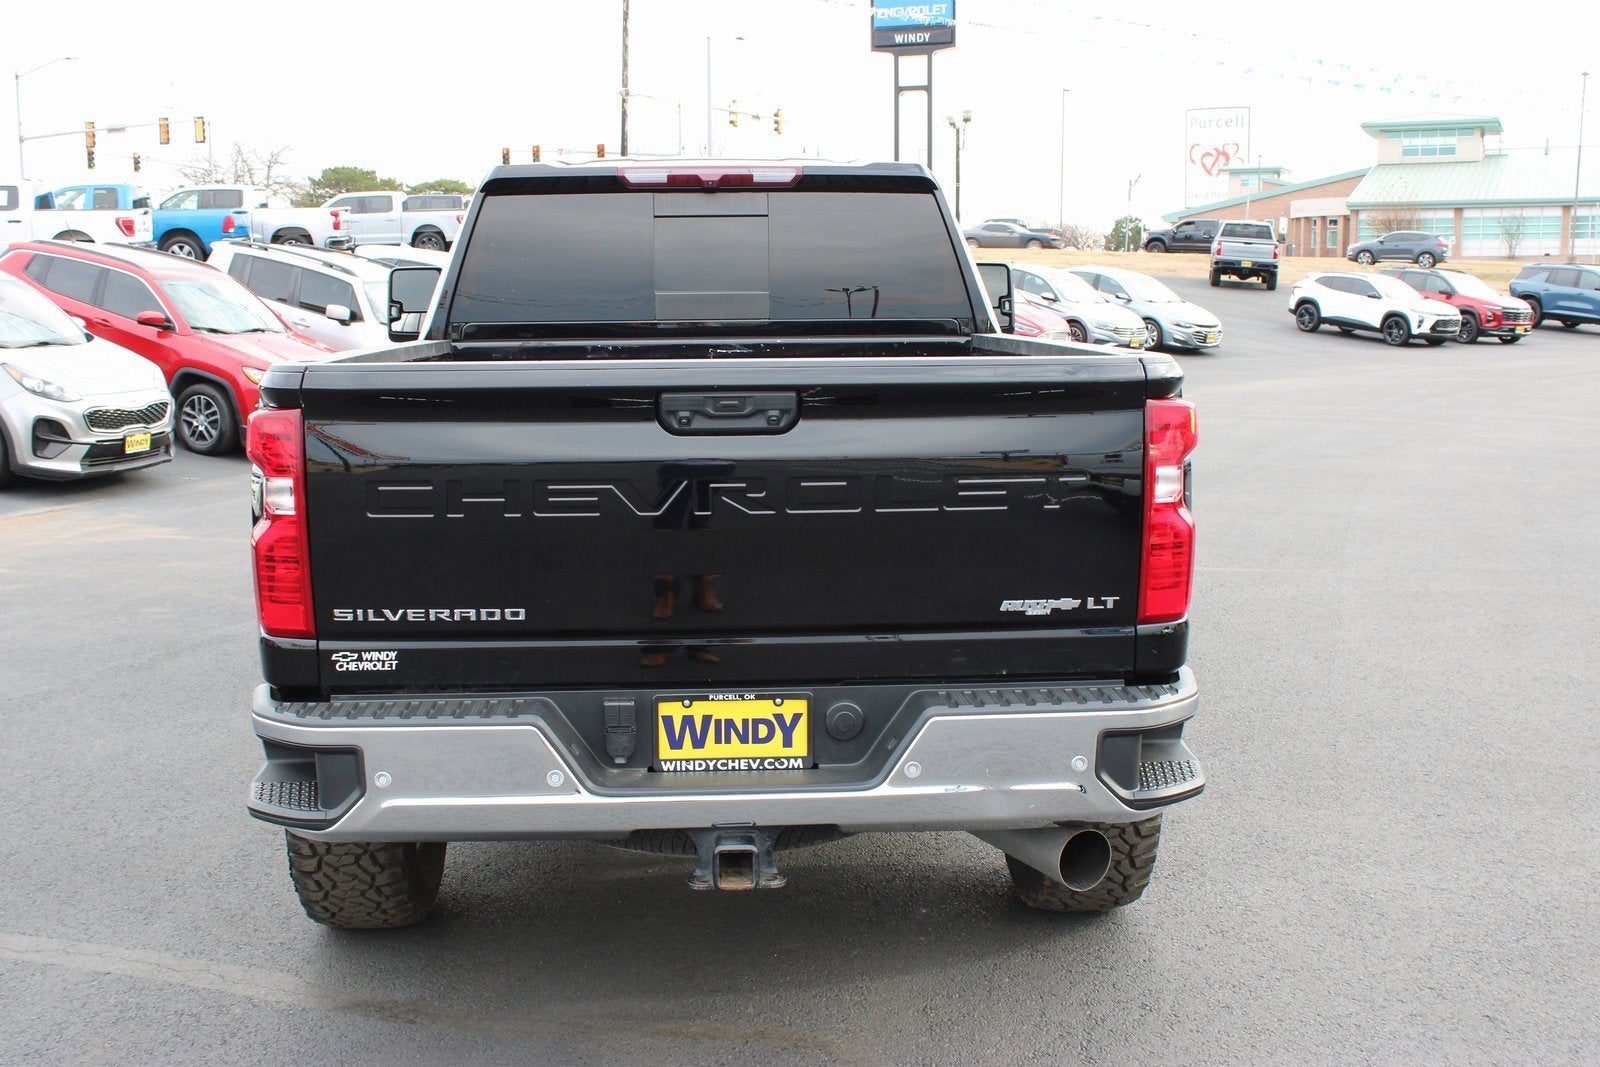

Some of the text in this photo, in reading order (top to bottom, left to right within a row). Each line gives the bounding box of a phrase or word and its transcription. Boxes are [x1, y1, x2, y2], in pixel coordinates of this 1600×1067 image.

[894, 32, 931, 44] WINDY
[1190, 114, 1244, 128] Purcell
[366, 474, 1088, 519] CHEVROLET
[1087, 596, 1120, 609] LT
[333, 608, 526, 622] SILVERADO
[361, 651, 398, 661] WINDY
[335, 660, 398, 671] CHEVROLET
[661, 712, 803, 750] WINDY
[661, 758, 803, 772] WINDYCHEV.COM
